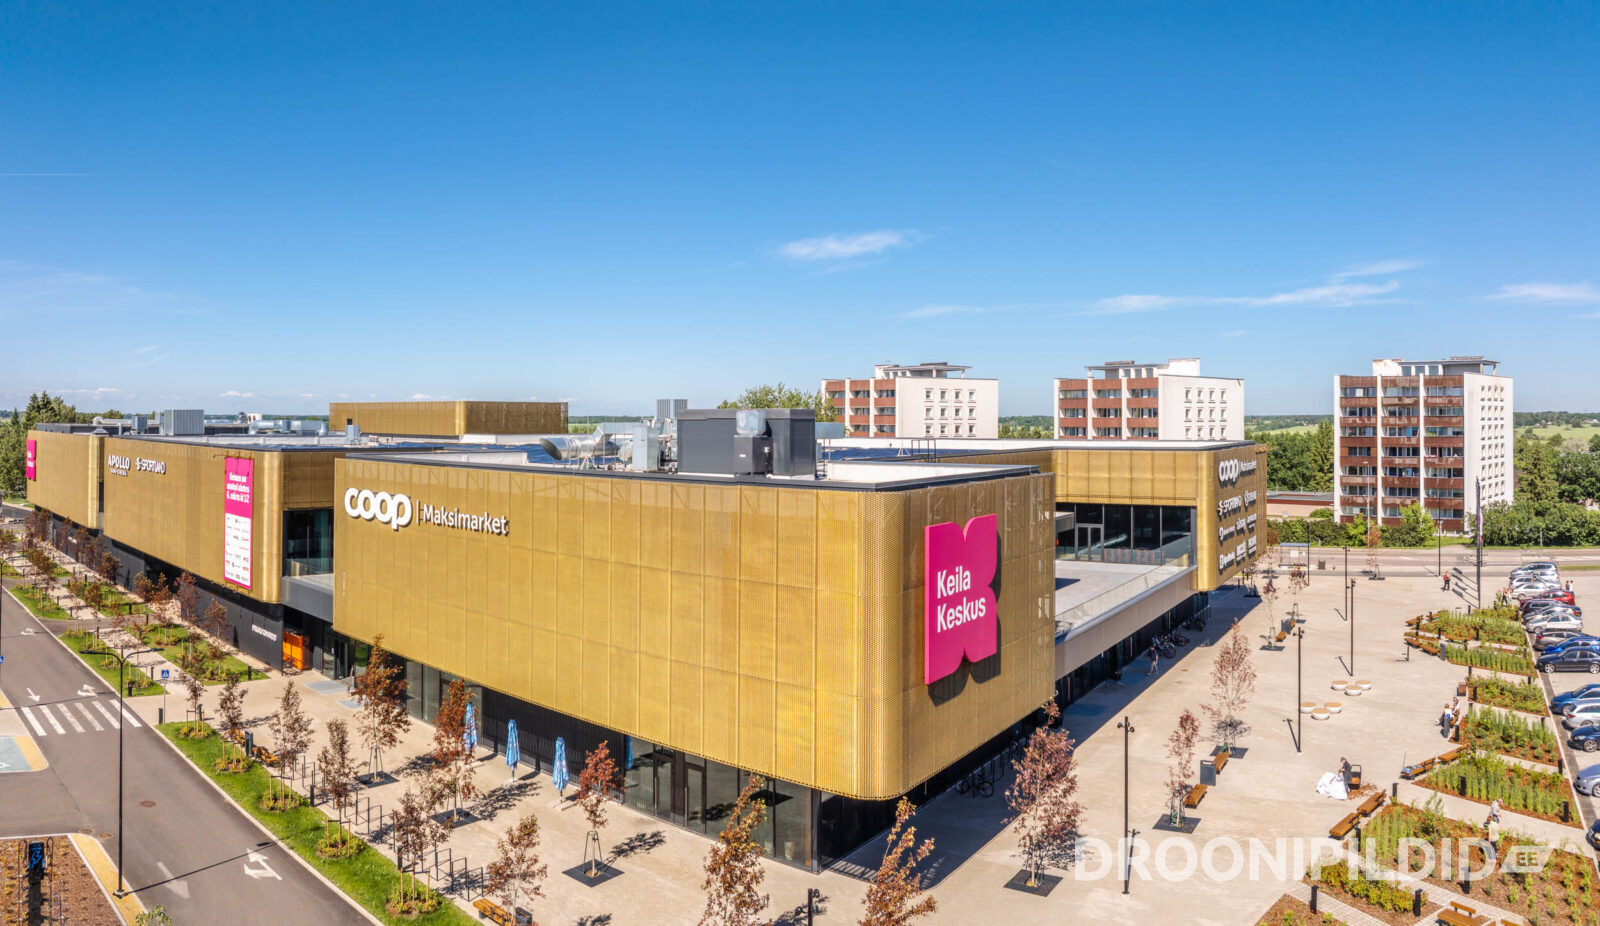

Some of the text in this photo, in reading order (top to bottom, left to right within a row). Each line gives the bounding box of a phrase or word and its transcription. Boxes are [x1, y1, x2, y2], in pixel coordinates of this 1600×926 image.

[108, 454, 130, 471] APOLLO
[423, 503, 508, 534] Maksimarket
[937, 565, 971, 599] Keila
[937, 596, 986, 633] Keskus
